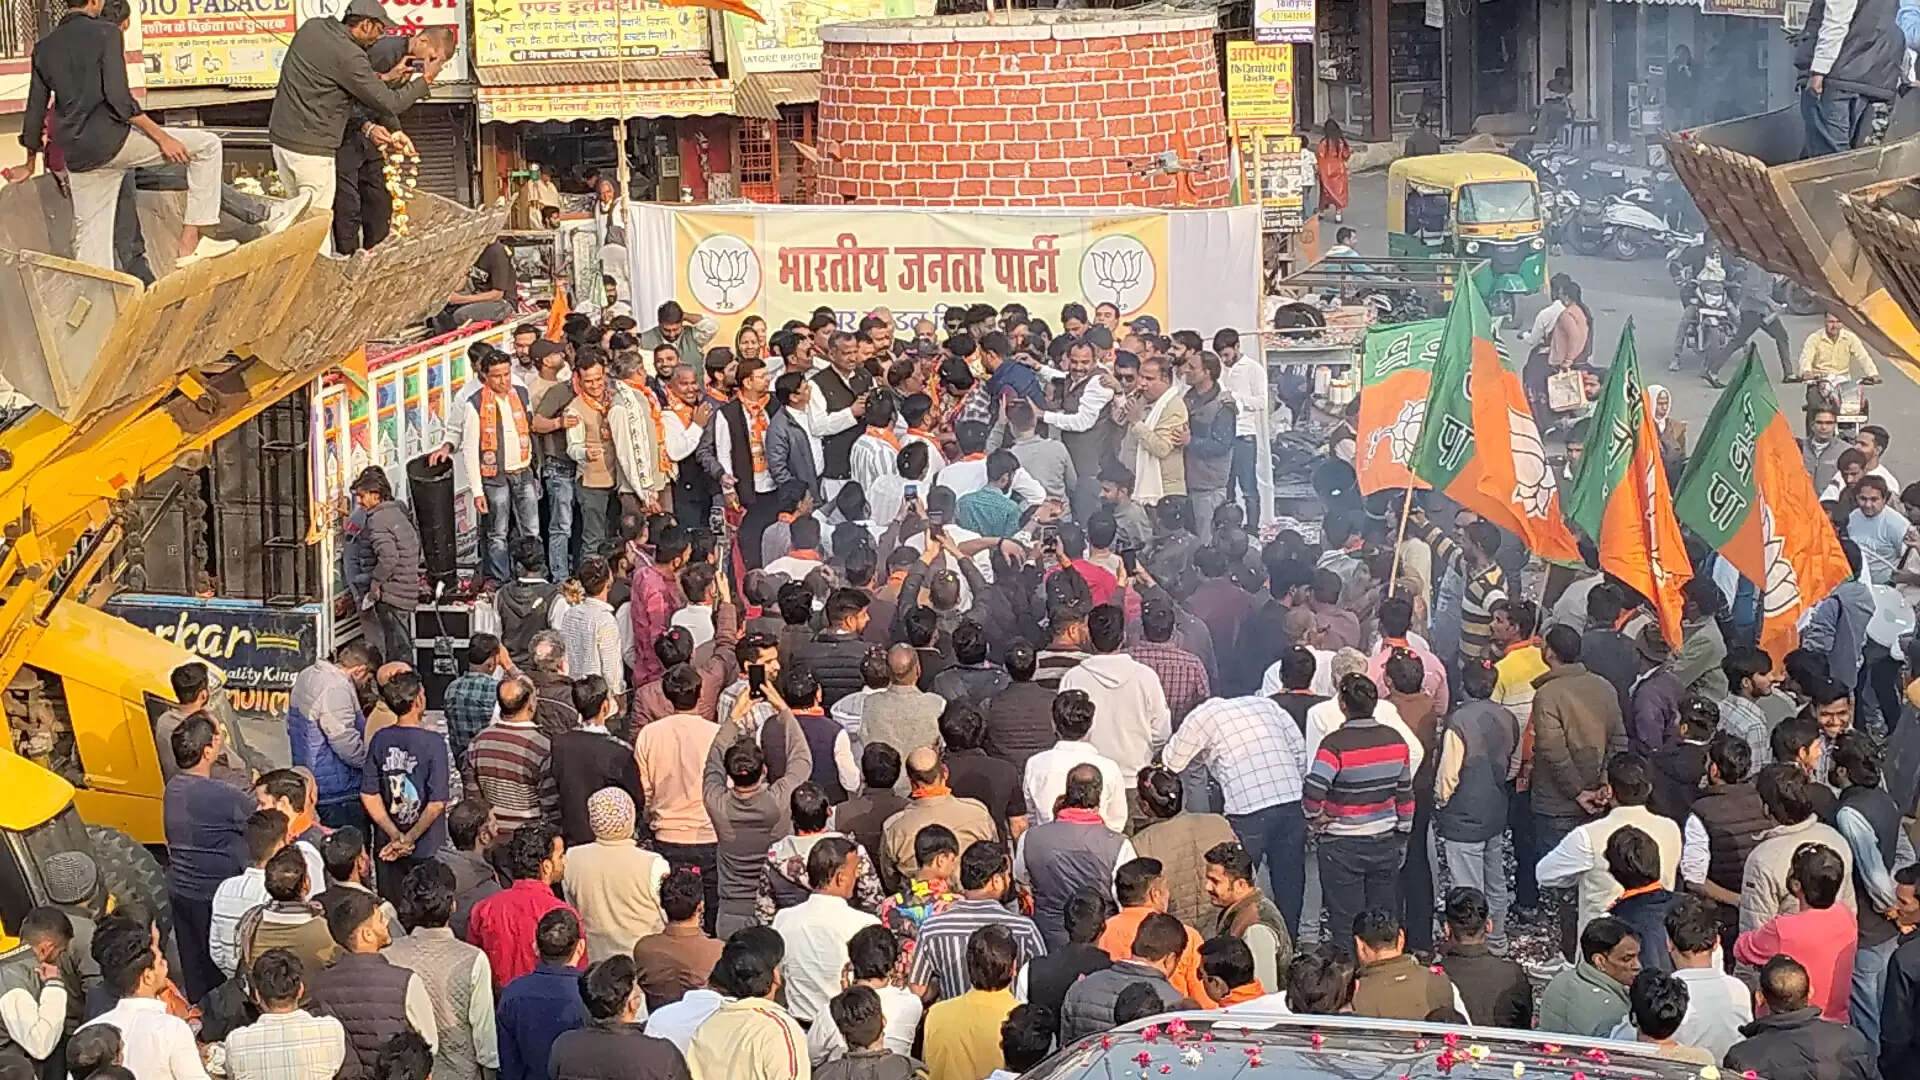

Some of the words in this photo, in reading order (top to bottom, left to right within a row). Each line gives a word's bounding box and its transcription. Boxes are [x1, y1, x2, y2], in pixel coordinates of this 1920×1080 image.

[188, 0, 289, 14] PALACE
[778, 232, 890, 293] भारतीय
[894, 246, 986, 293] जनता
[991, 234, 1061, 293] पार्टी
[263, 666, 300, 687] King
